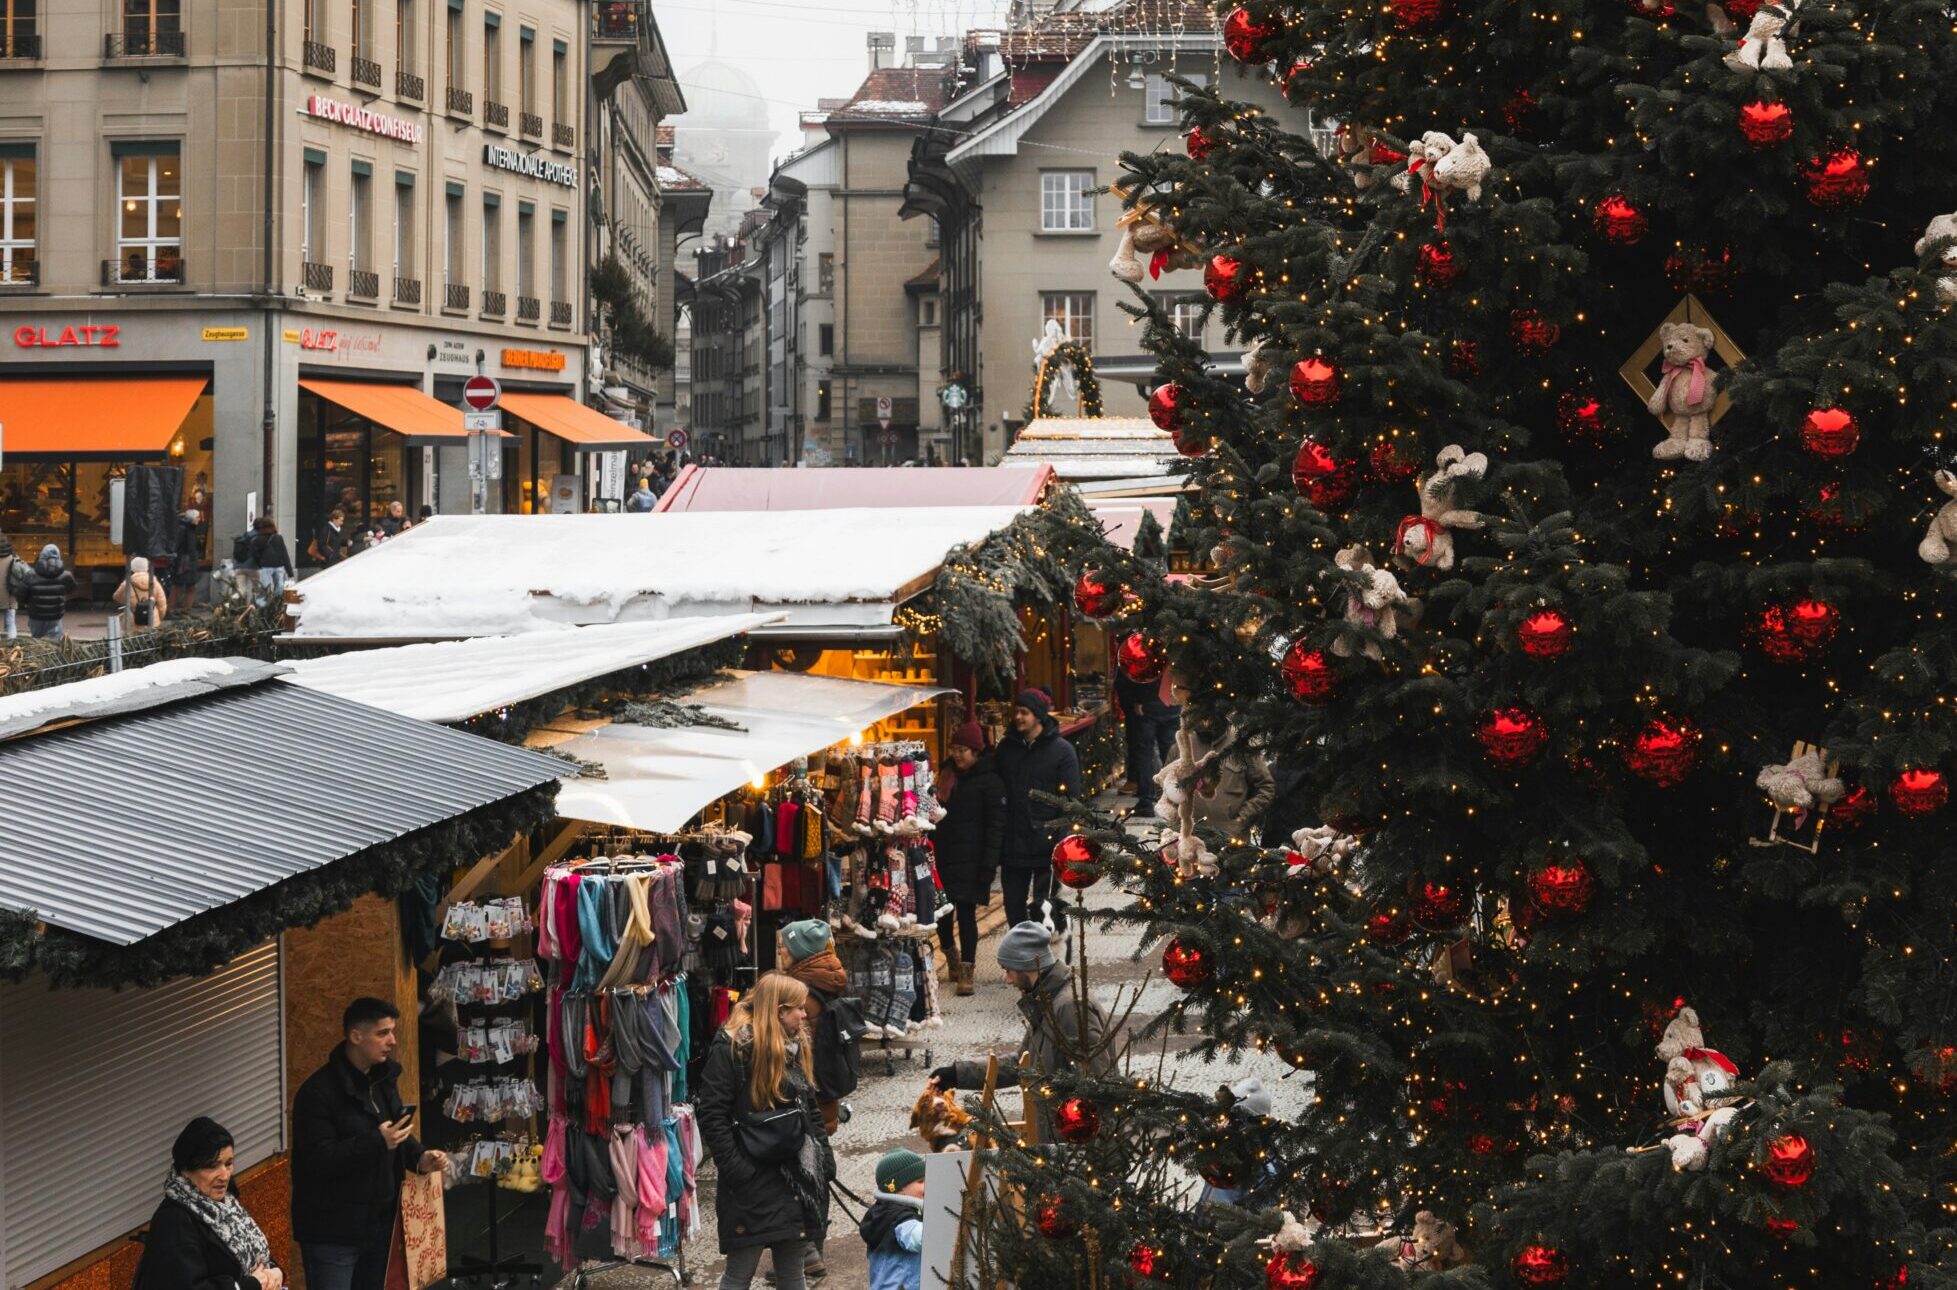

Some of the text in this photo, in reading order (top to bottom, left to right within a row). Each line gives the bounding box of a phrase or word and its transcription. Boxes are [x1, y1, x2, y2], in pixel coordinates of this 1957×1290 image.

[315, 96, 423, 144] BECK GLATZ CONFISEUR
[544, 160, 578, 186] APOTHEKE
[14, 325, 120, 347] GLATZ
[301, 327, 338, 351] GLATZ
[439, 352, 469, 364] ZEUGHAUS
